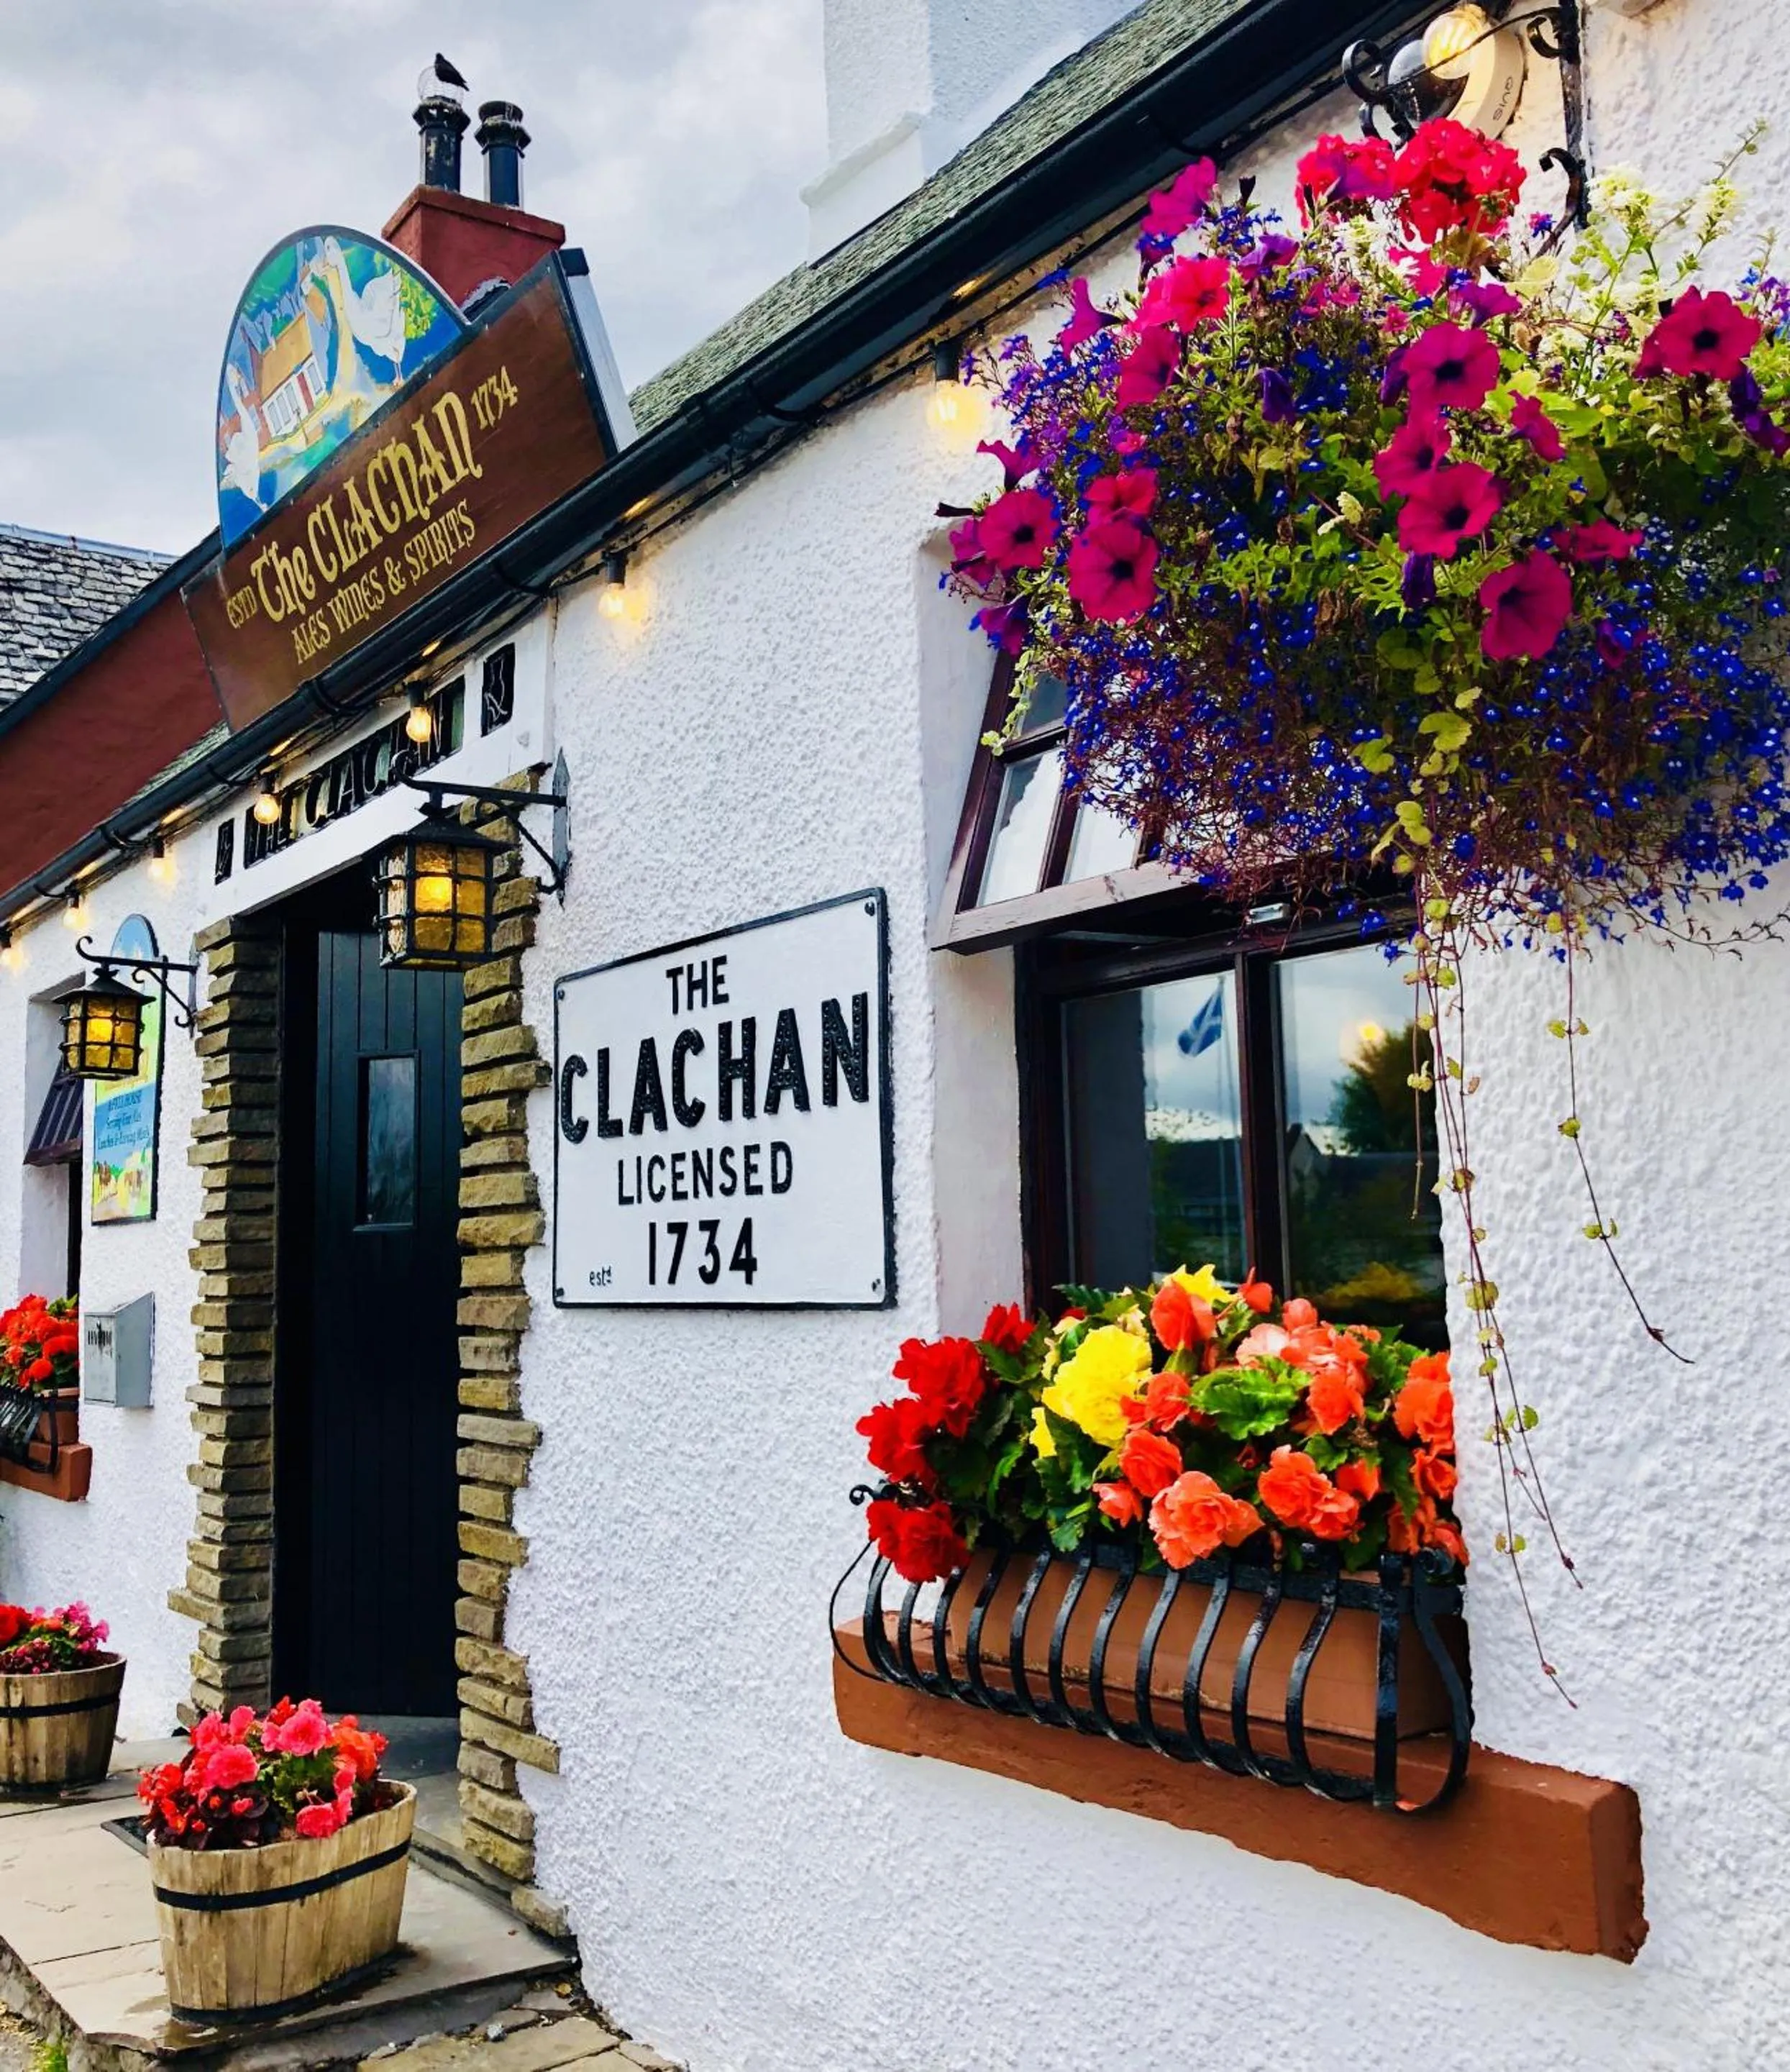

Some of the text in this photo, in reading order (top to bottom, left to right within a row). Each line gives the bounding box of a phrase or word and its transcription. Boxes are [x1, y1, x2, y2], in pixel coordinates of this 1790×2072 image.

[470, 365, 519, 430] 1734
[291, 498, 476, 665] ALES WINES & SPIRITS
[666, 955, 730, 1015] THE
[560, 992, 869, 1144] CLACHAN
[618, 1141, 793, 1206] LICENSED
[648, 1217, 758, 1285] 1734
